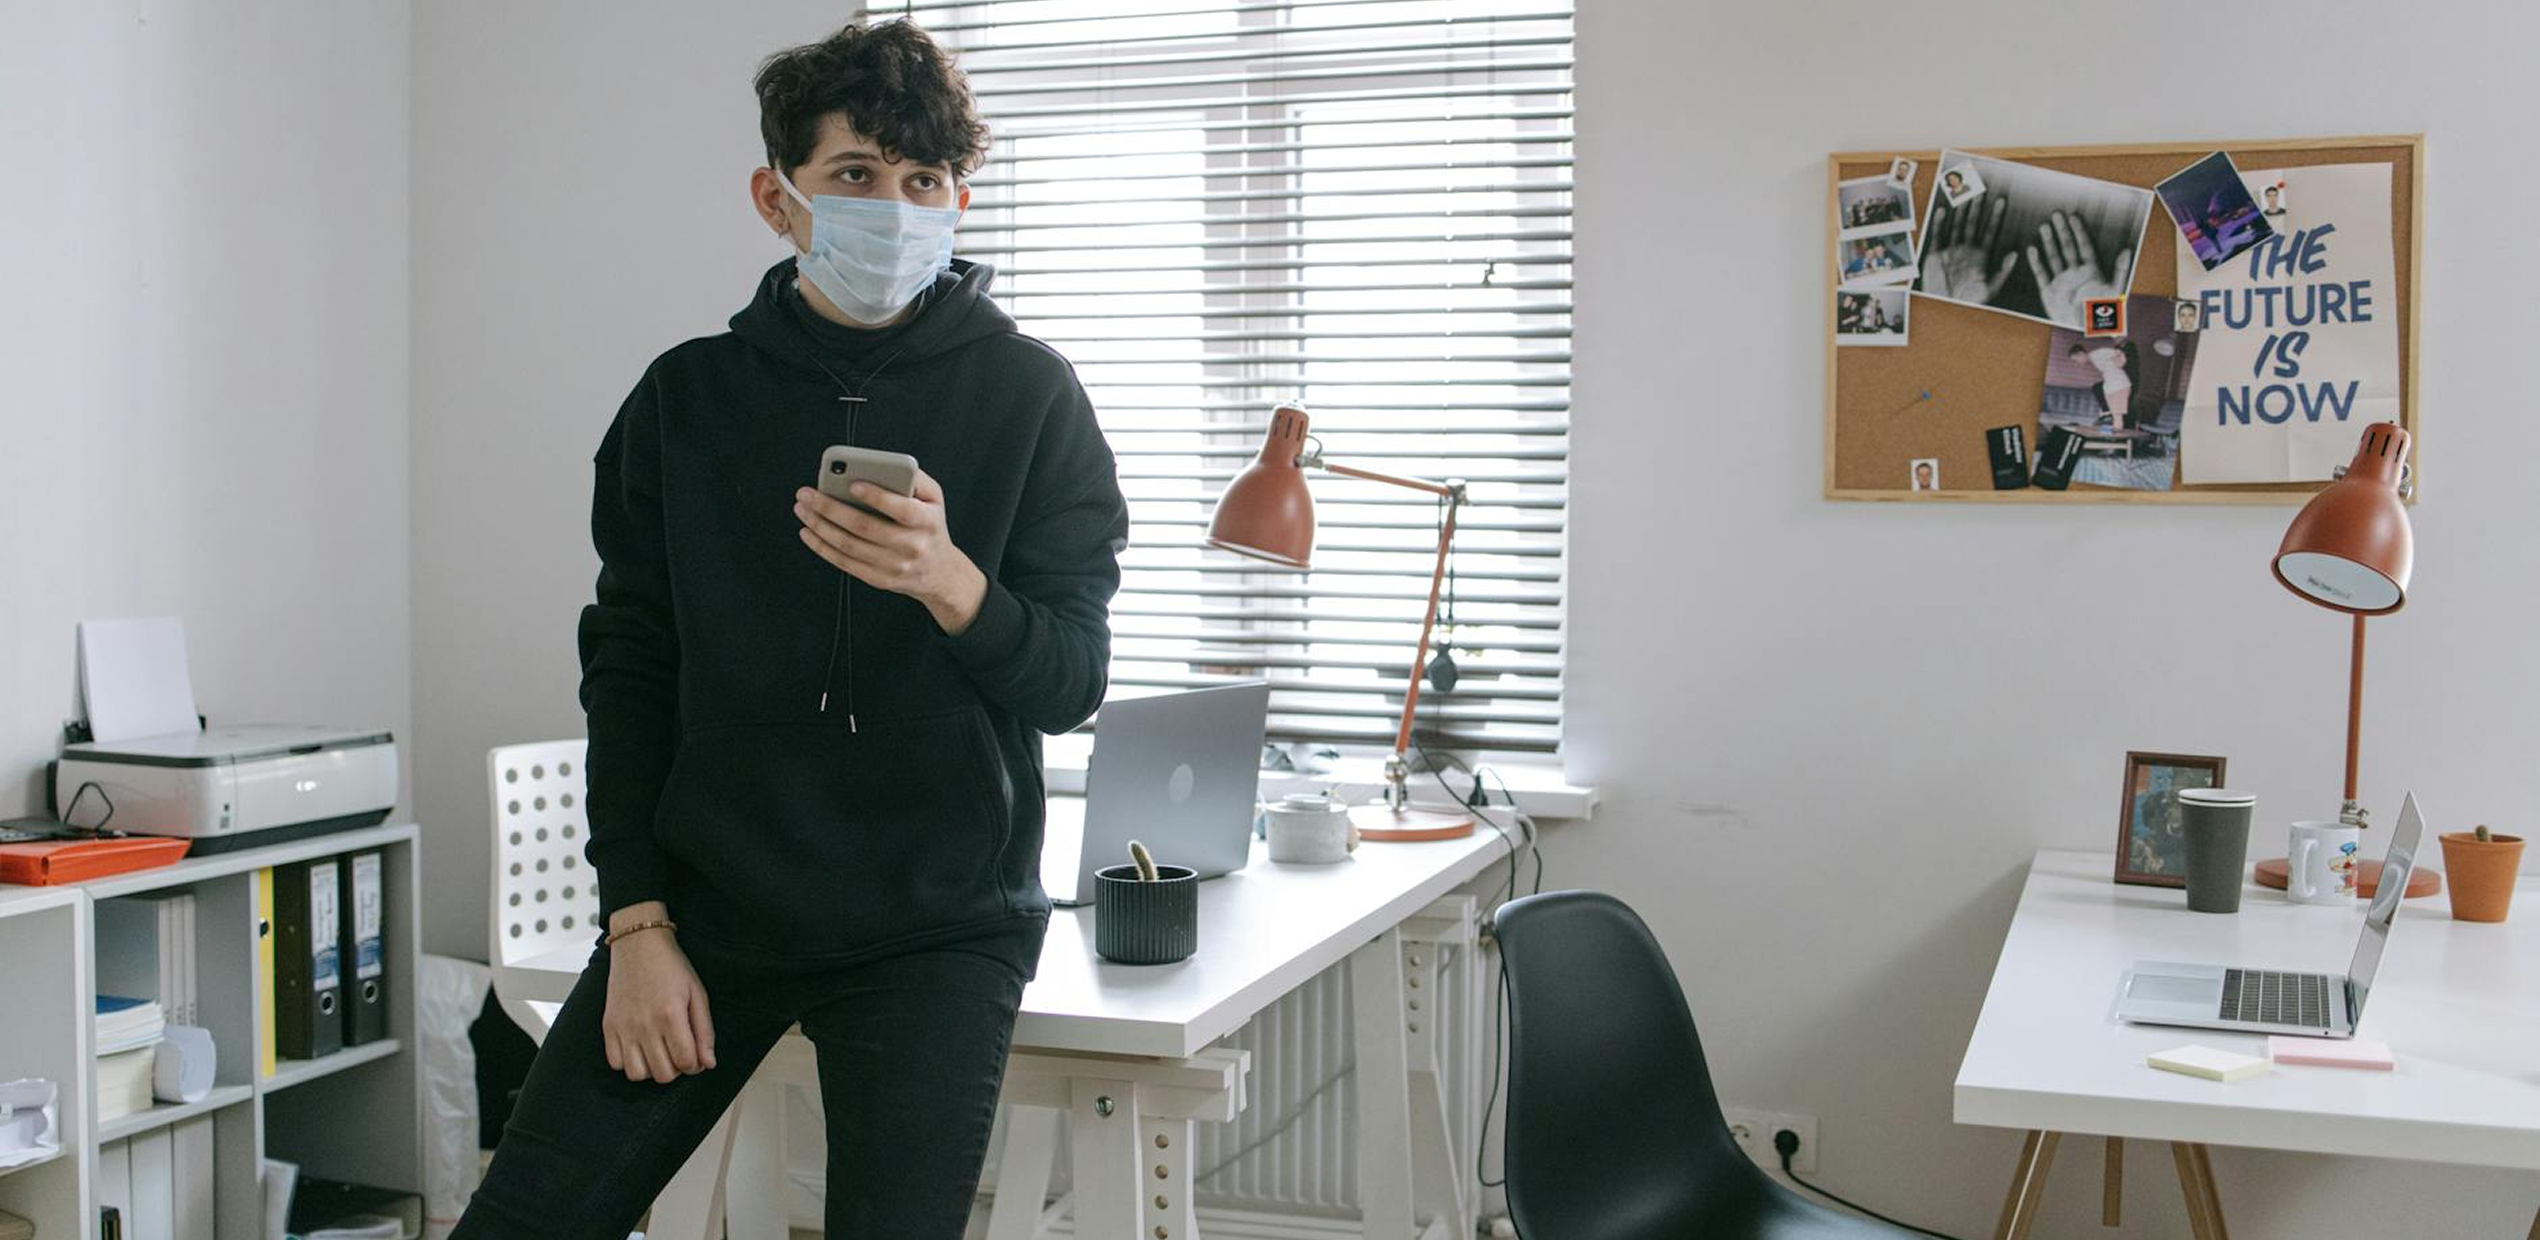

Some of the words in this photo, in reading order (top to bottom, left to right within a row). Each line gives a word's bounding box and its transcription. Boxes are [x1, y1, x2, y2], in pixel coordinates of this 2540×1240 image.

[2200, 280, 2372, 329] FUTURE
[2253, 330, 2310, 379] IS
[2217, 380, 2359, 426] NOW
